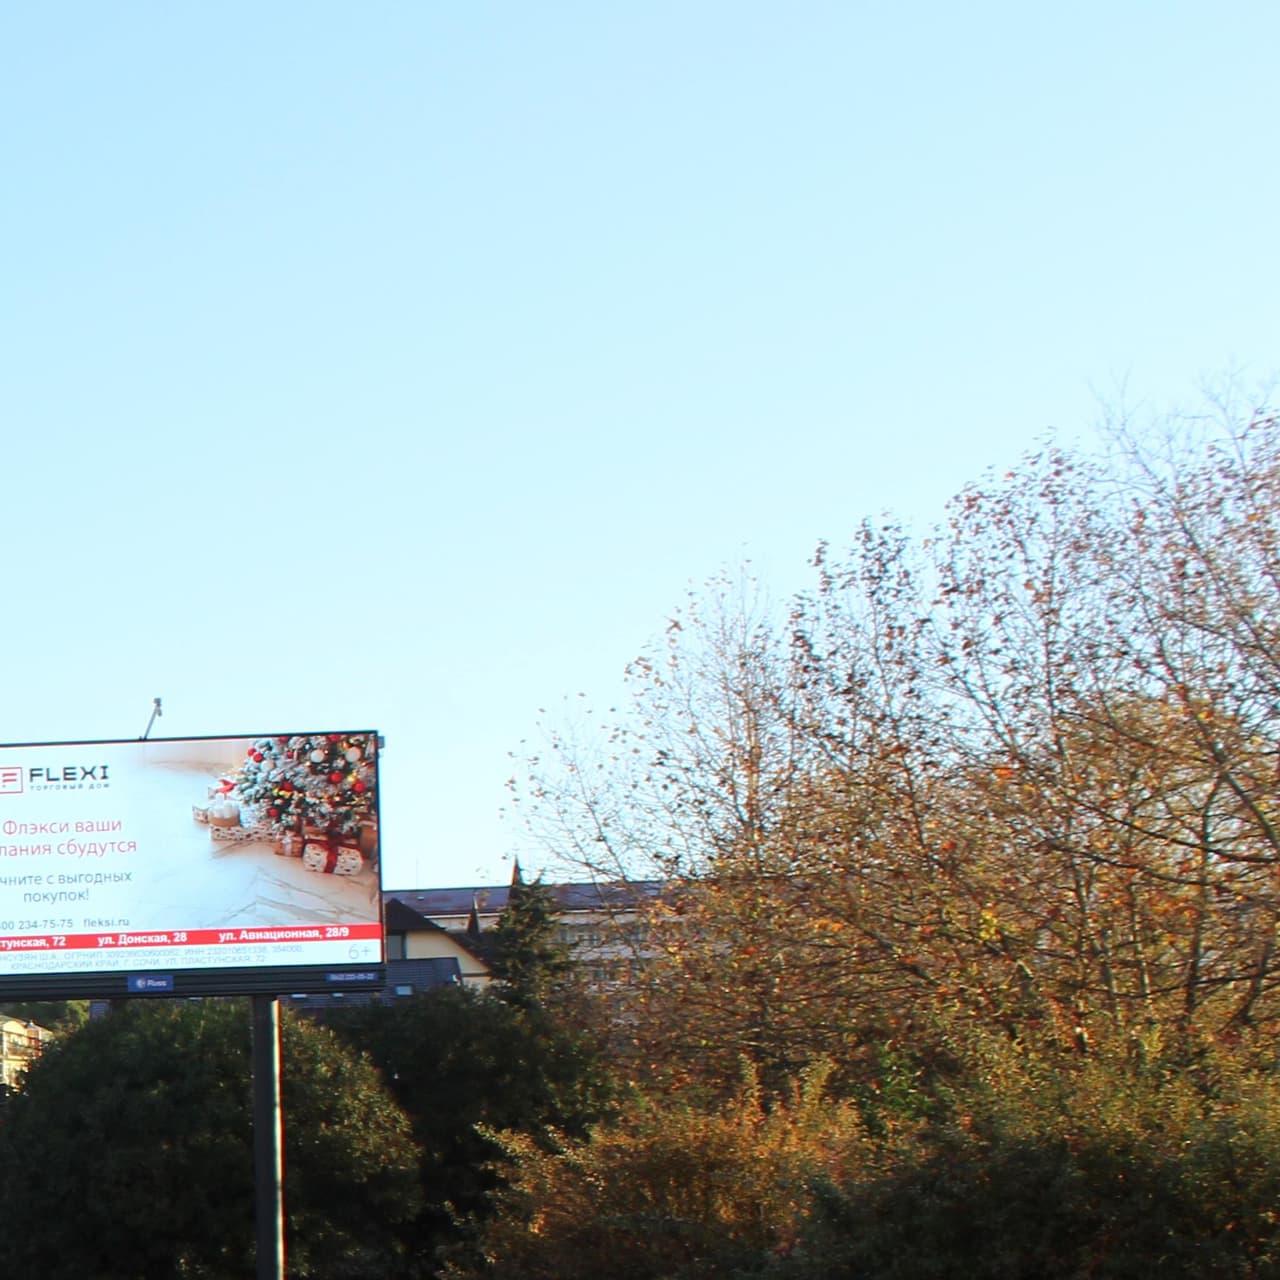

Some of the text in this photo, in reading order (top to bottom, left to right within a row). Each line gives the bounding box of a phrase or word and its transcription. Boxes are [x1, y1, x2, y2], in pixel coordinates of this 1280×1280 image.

[29, 765, 110, 783] FLEXI
[2, 819, 70, 836] Флэкси
[75, 819, 122, 833] ваши
[56, 838, 137, 859] сбудутся
[46, 875, 55, 885] с
[58, 872, 133, 886] выгодных
[23, 888, 90, 905] покупок!
[18, 919, 73, 930] 234-75-75
[83, 917, 130, 928] fleksi.ru
[52, 936, 66, 947] 72
[97, 932, 188, 948] ул. Донская, 28
[218, 927, 350, 943] ул. Авиационная, 28/9
[348, 944, 371, 960] 6+
